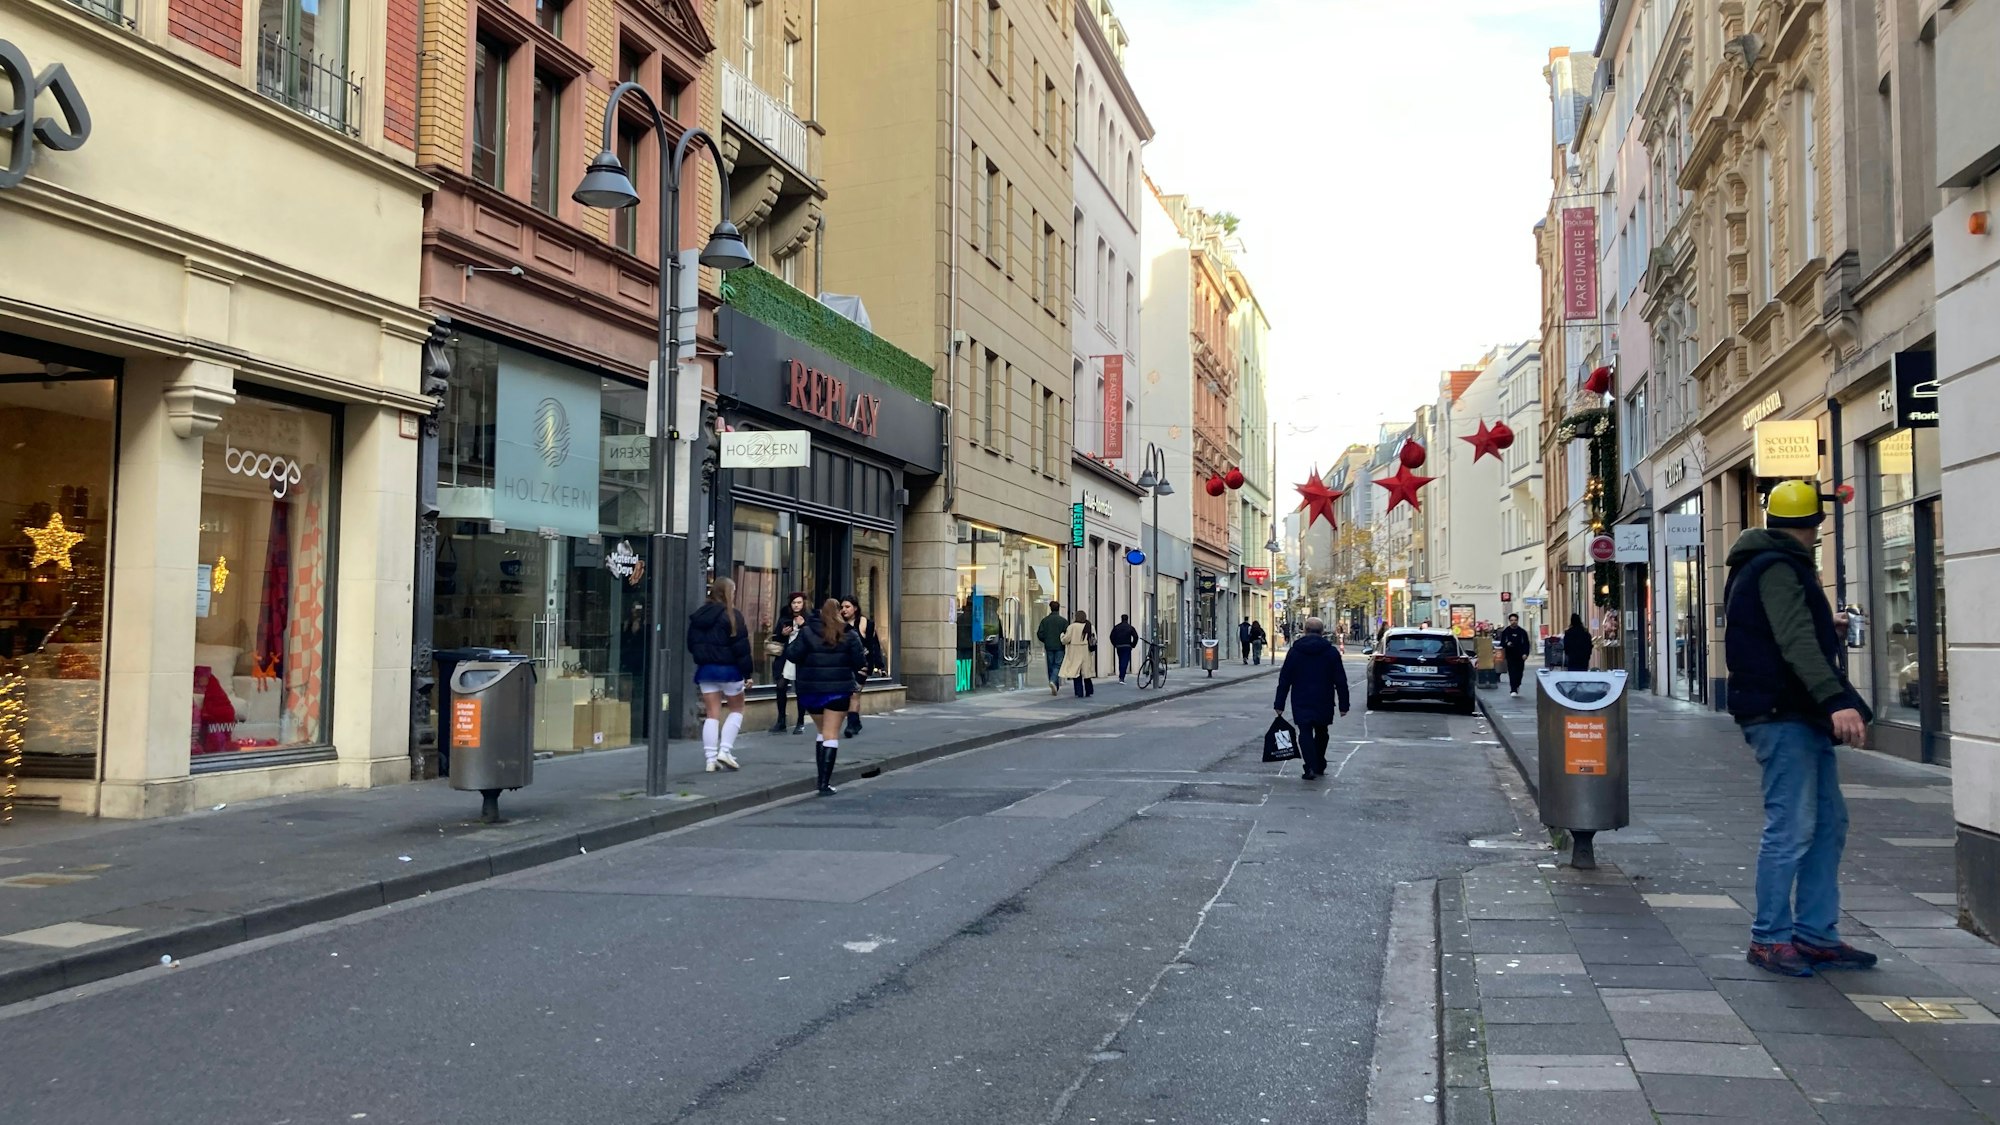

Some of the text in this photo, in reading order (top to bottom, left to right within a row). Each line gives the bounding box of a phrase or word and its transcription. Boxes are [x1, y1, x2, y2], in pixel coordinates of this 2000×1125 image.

[1574, 229, 1587, 307] PARFÜMERIE
[787, 358, 881, 438] REPLAY
[1109, 372, 1117, 402] BEAUTY
[1109, 405, 1117, 448] AKADEMIE
[1765, 436, 1809, 445] SCOTCH
[727, 443, 798, 456] HOLZKERN
[1778, 445, 1810, 453] SODA
[225, 434, 302, 499] boogs
[504, 475, 592, 510] HOLZKERN
[1073, 503, 1084, 547] WEEKDAY
[611, 552, 639, 564] Material
[616, 563, 633, 577] Days
